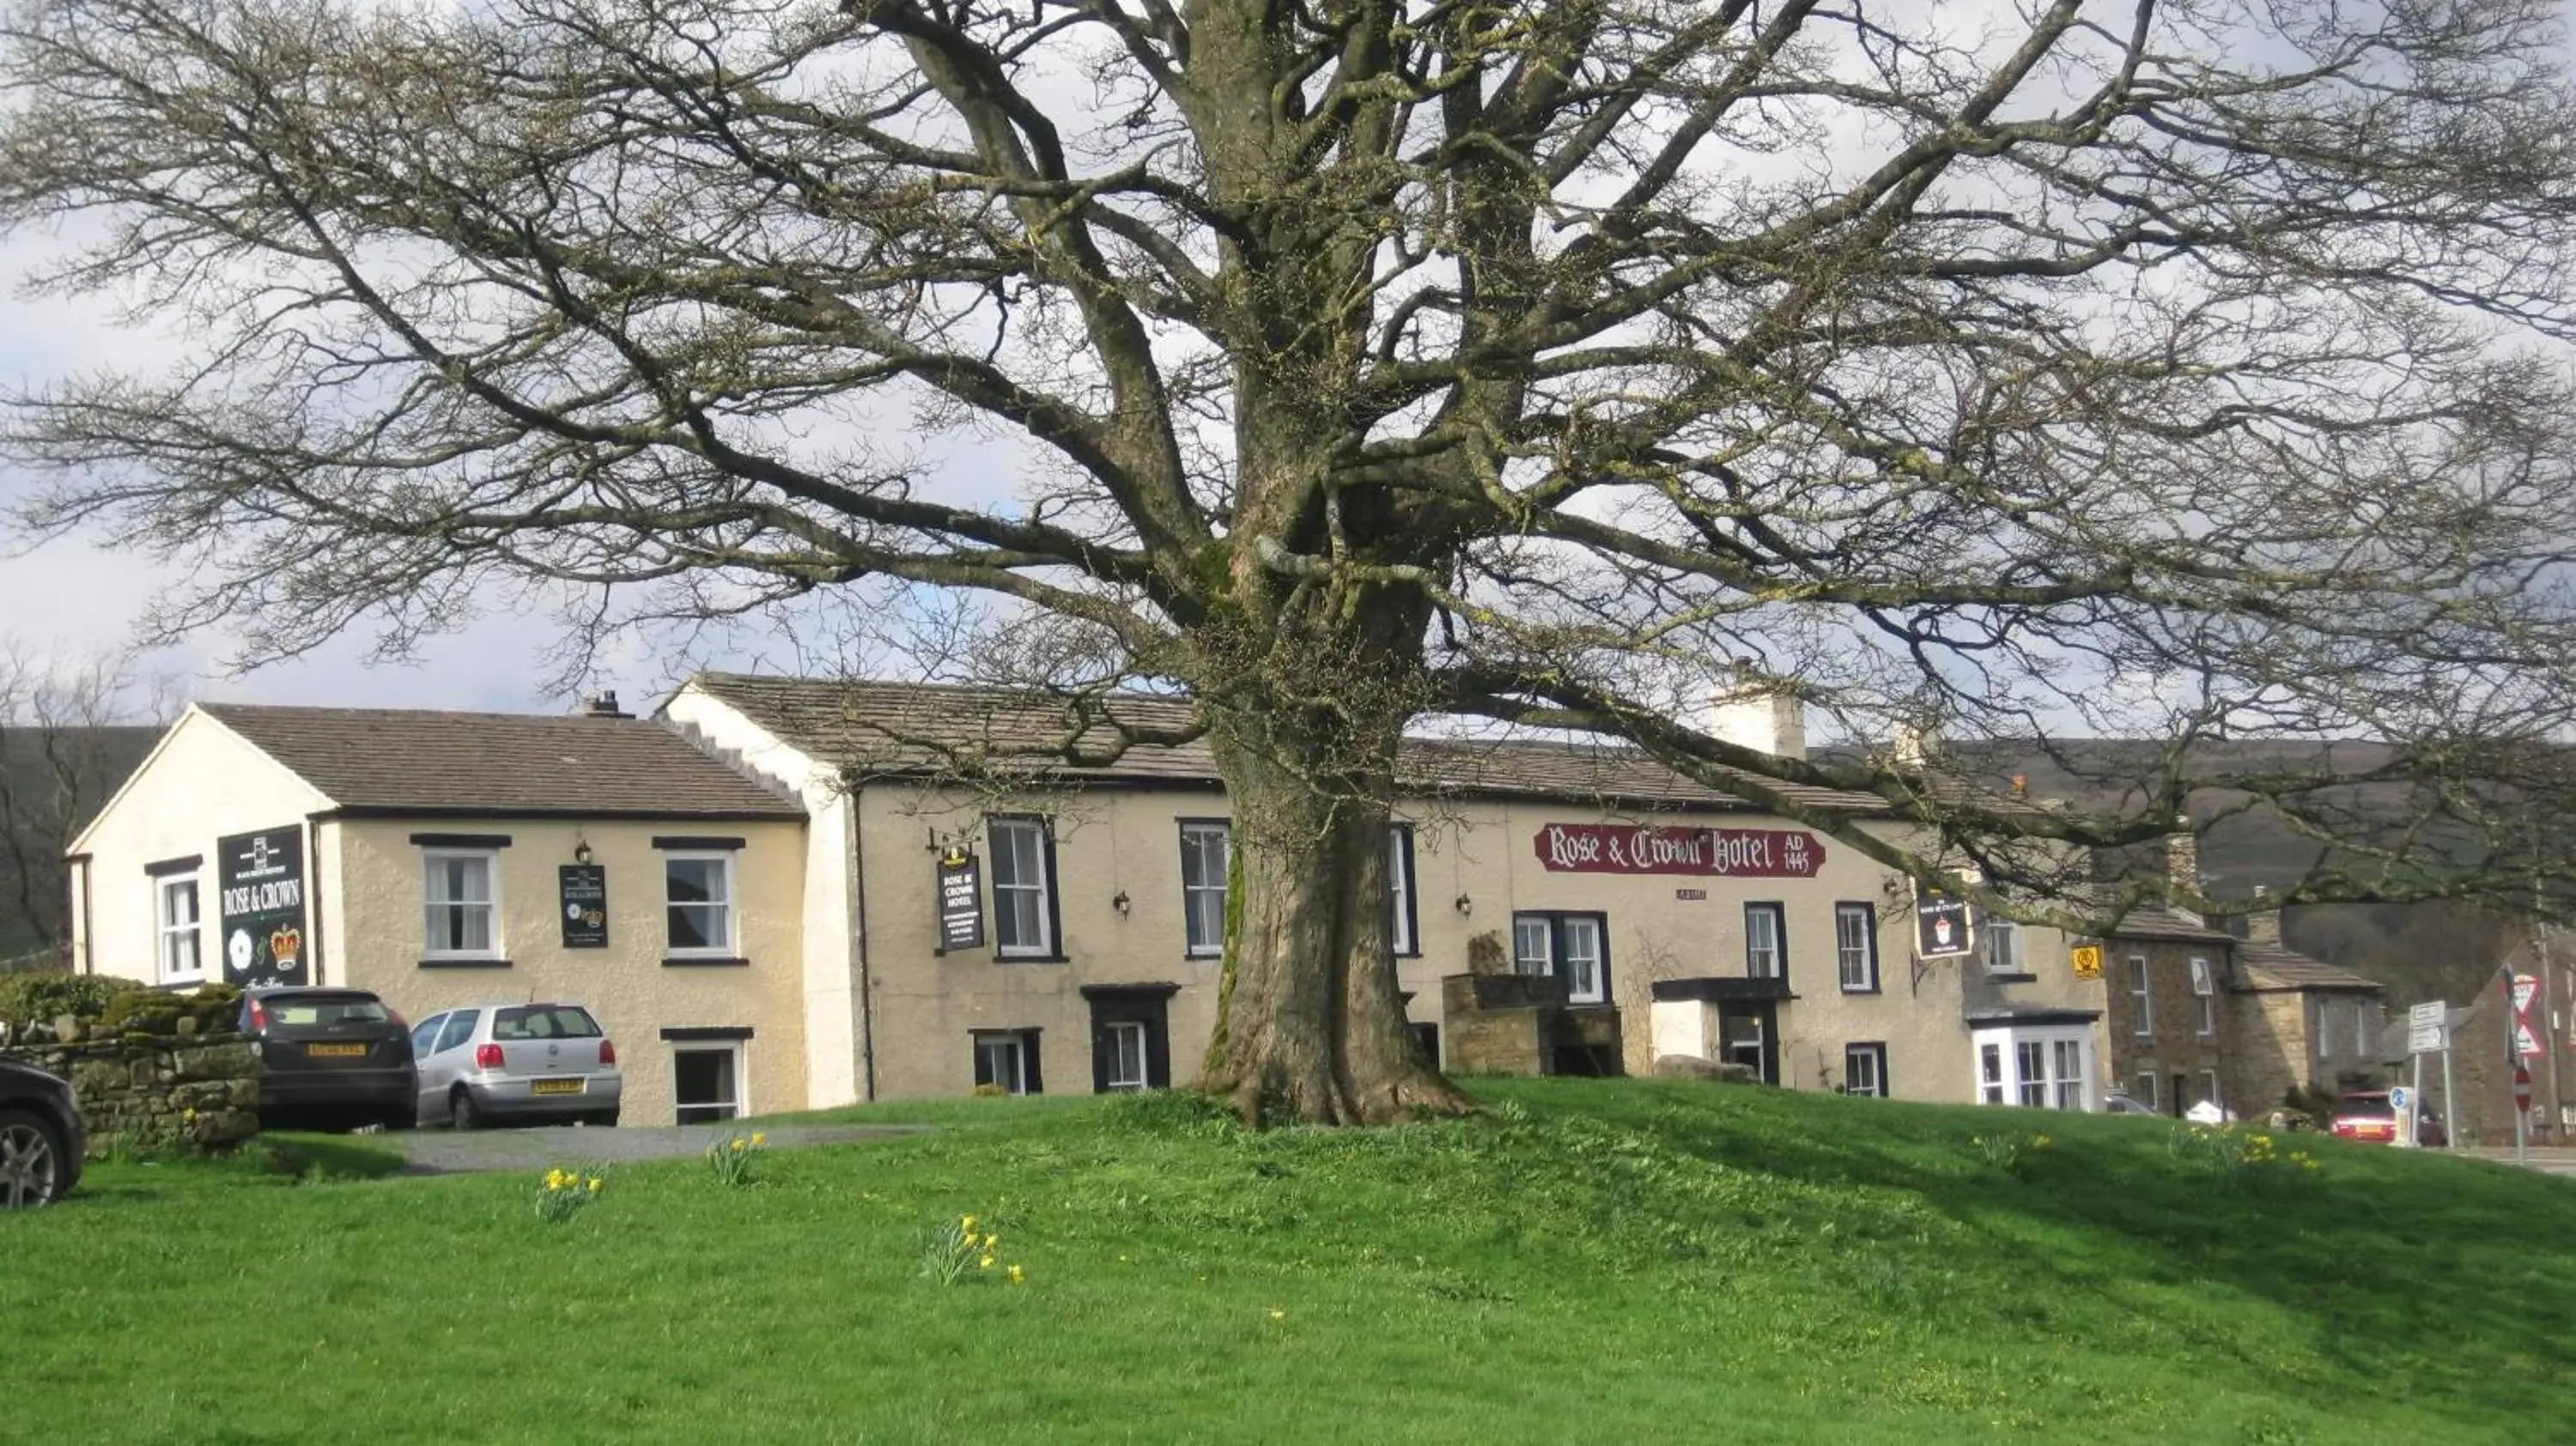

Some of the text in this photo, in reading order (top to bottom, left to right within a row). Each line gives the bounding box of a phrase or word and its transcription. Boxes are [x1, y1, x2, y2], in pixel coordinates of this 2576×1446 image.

[1548, 826, 1774, 873] Rose & Crown Hotel
[1784, 835, 1804, 850] AD
[224, 878, 300, 916] ROSE & CROWN
[947, 896, 972, 908] HOTEL
